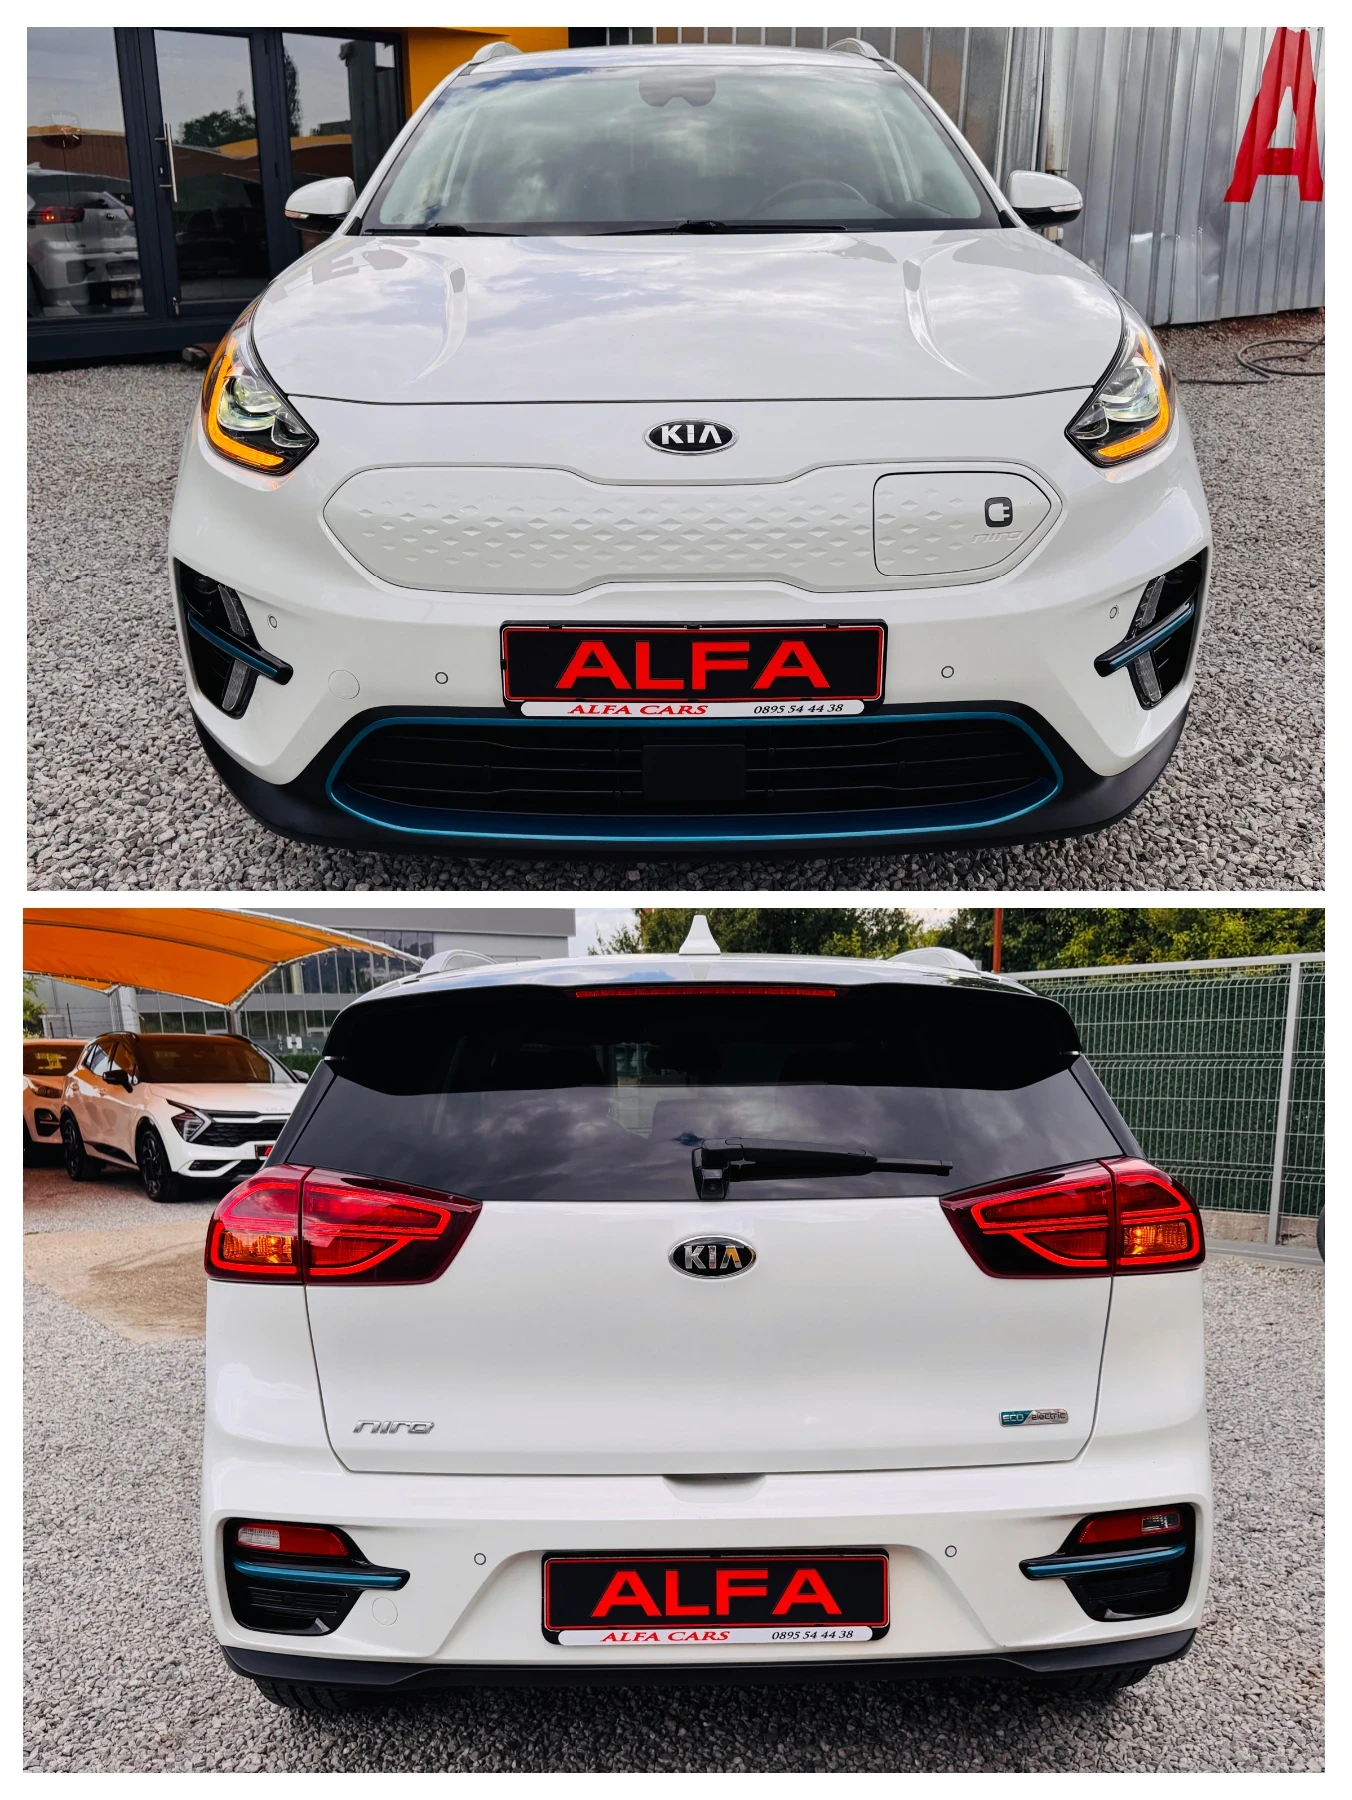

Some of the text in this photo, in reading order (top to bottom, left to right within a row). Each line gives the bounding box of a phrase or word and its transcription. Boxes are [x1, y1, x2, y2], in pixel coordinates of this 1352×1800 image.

[661, 424, 722, 445] KIA
[555, 639, 831, 690] ALFA
[567, 704, 708, 715] ALFA CARS
[753, 704, 844, 714] 0895 54 44 38
[684, 1245, 743, 1269] KIA
[1003, 1411, 1066, 1422] ECO electric
[591, 1568, 842, 1617] ALFA
[600, 1631, 730, 1642] ALFA CARS
[771, 1630, 854, 1640] 0895 54 44 38
